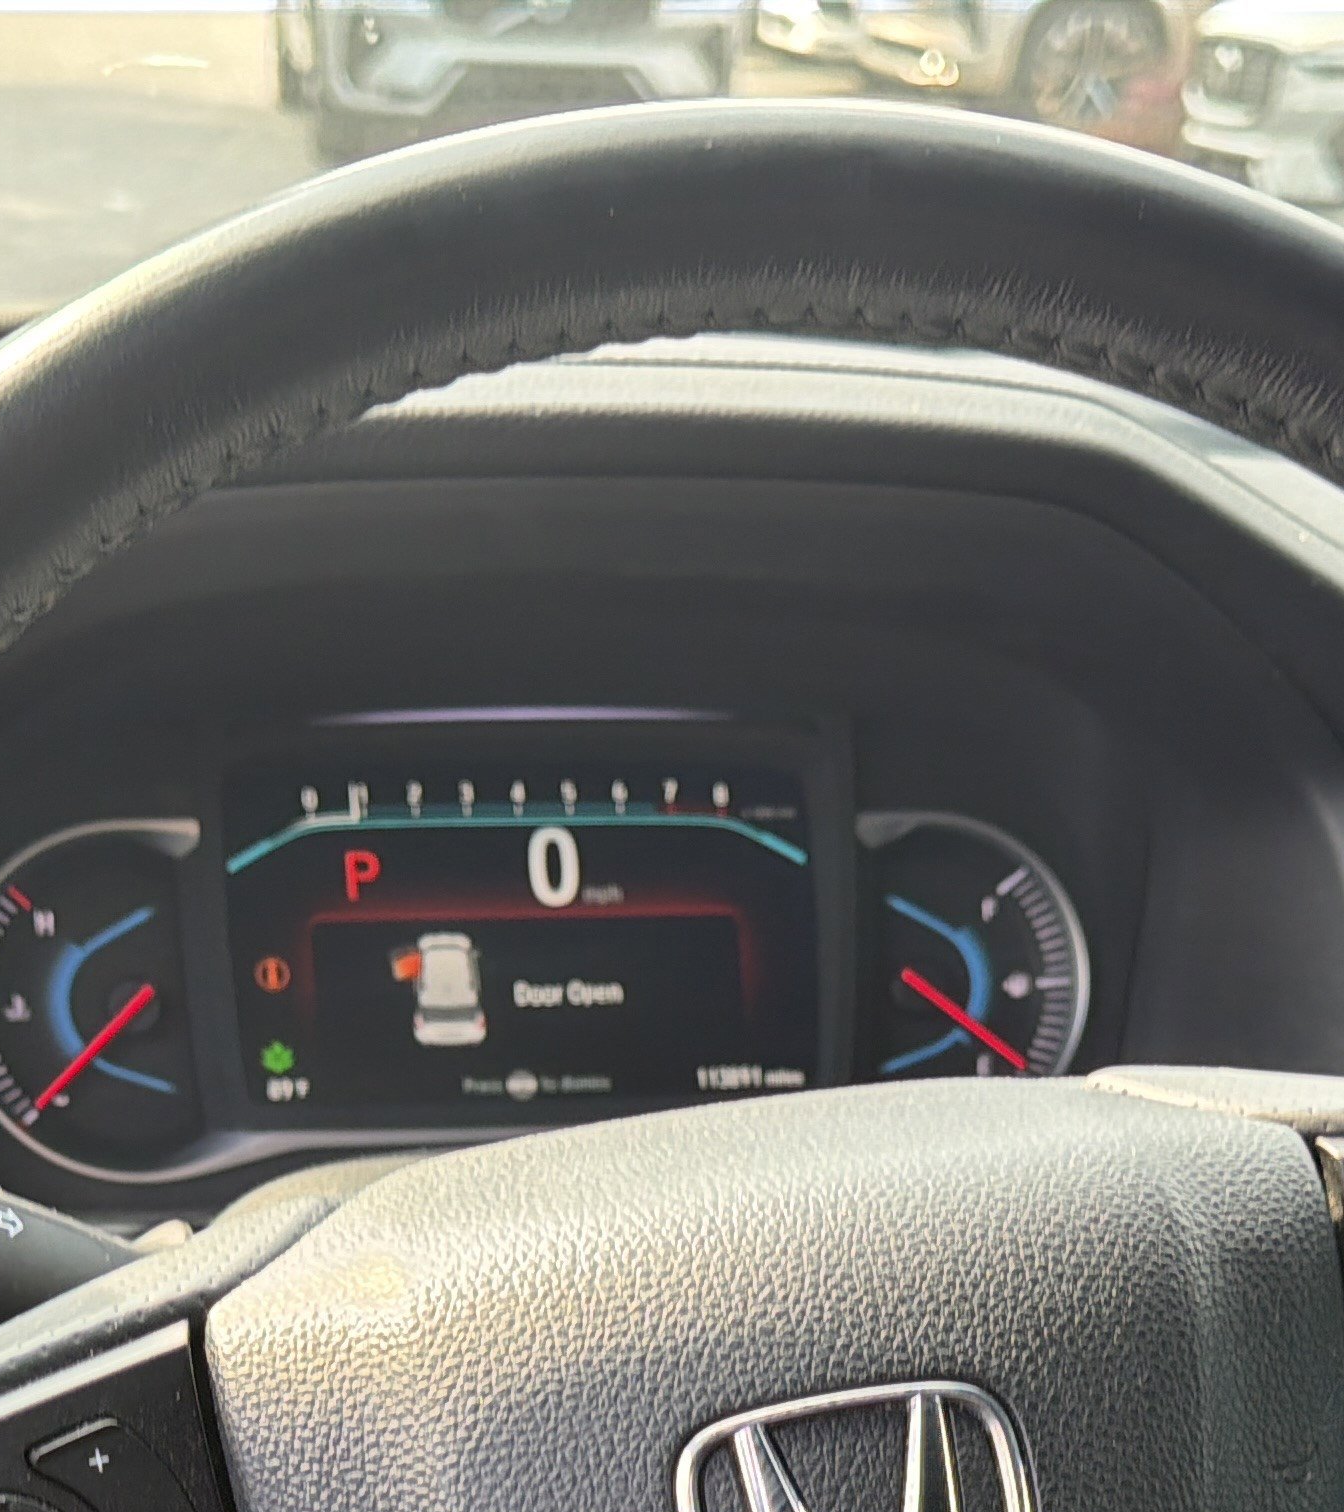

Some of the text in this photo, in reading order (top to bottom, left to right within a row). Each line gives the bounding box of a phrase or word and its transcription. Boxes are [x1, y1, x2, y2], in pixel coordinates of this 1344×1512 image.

[343, 849, 382, 902] P
[526, 825, 580, 909] 0
[513, 977, 625, 1009] Door Open
